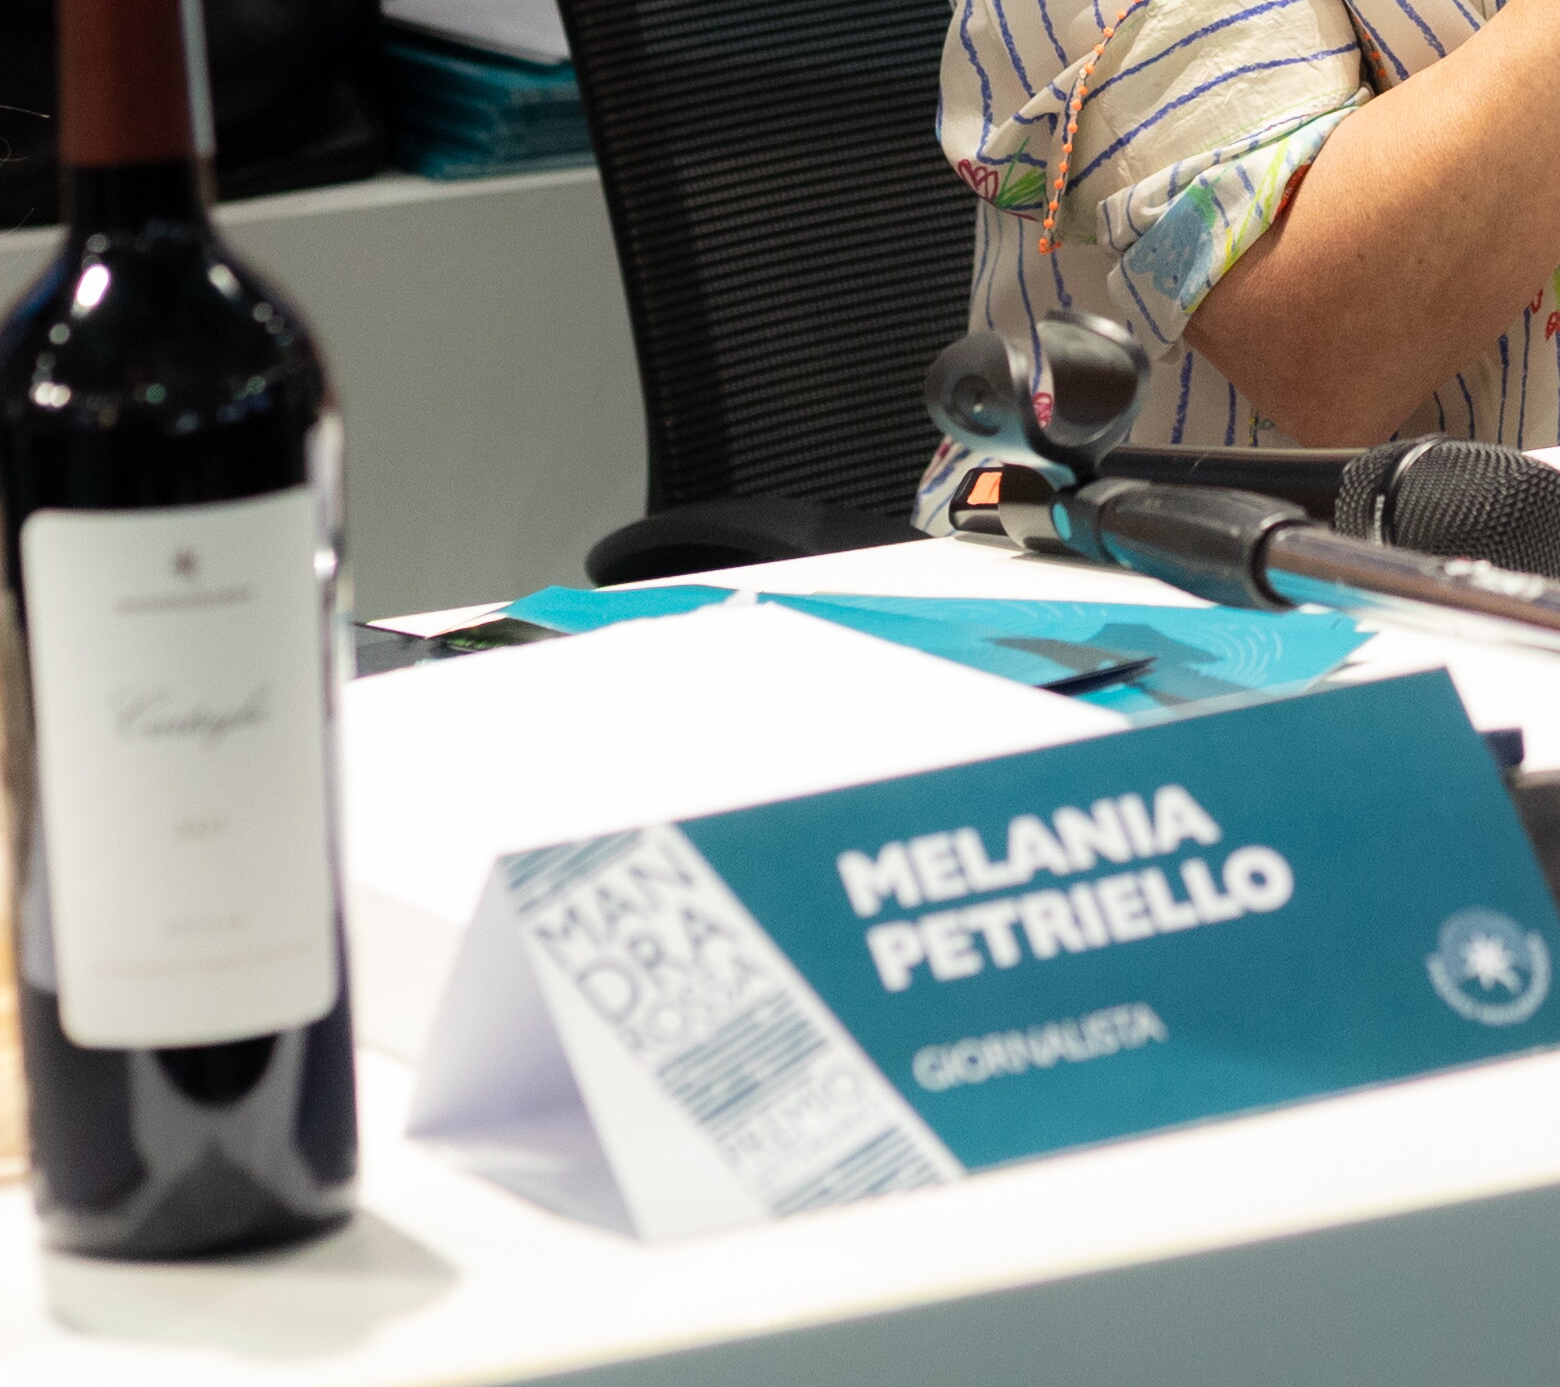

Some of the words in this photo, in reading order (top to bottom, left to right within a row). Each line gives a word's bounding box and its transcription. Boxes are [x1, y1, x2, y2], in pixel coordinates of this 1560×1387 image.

[835, 783, 1223, 918] MELANIA
[866, 843, 1295, 992] PETRIELLO
[912, 1001, 1169, 1093] GIORNALISTA
